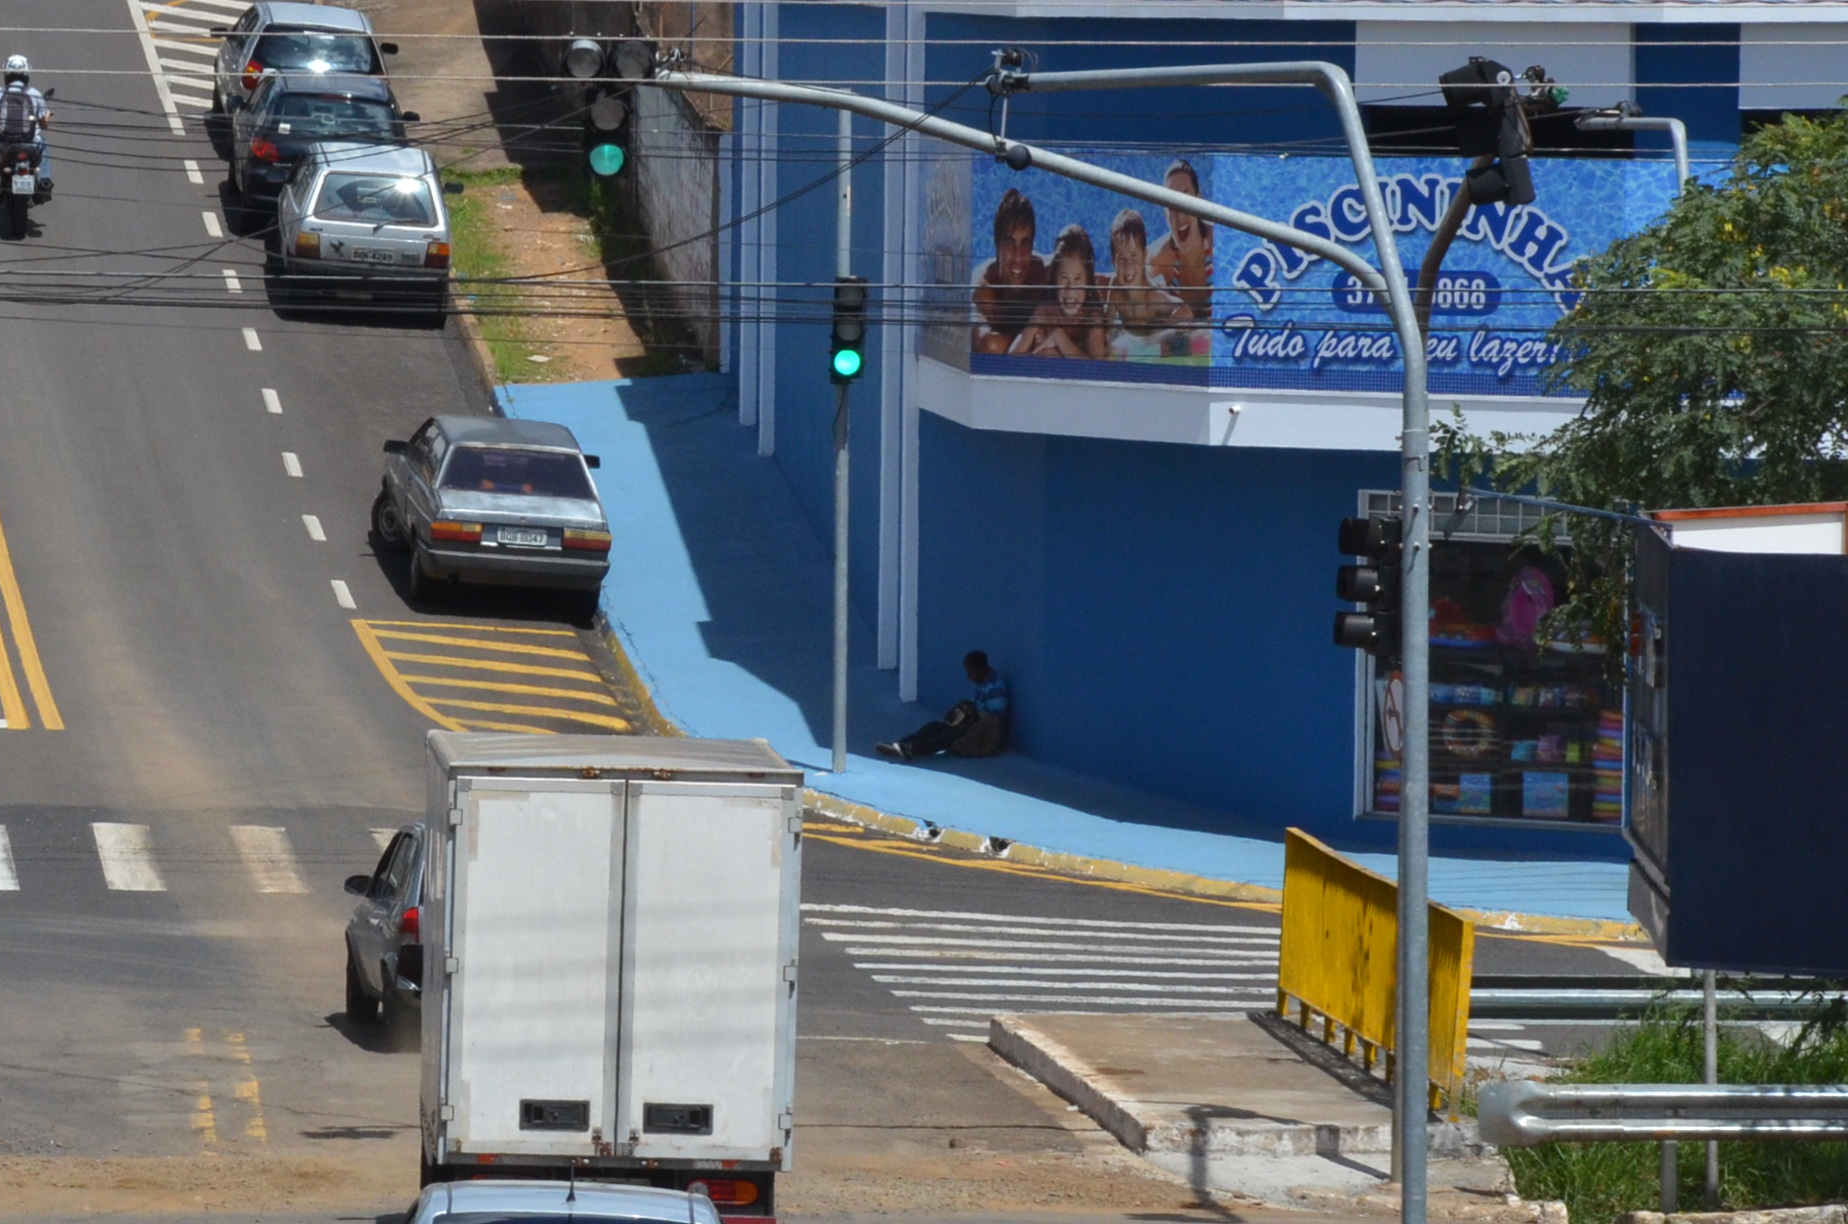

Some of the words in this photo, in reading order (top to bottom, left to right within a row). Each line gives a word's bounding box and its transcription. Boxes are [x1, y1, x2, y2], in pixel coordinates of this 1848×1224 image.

[1223, 317, 1304, 358] Tudo
[1314, 331, 1394, 368] para
[1427, 337, 1457, 361] eu
